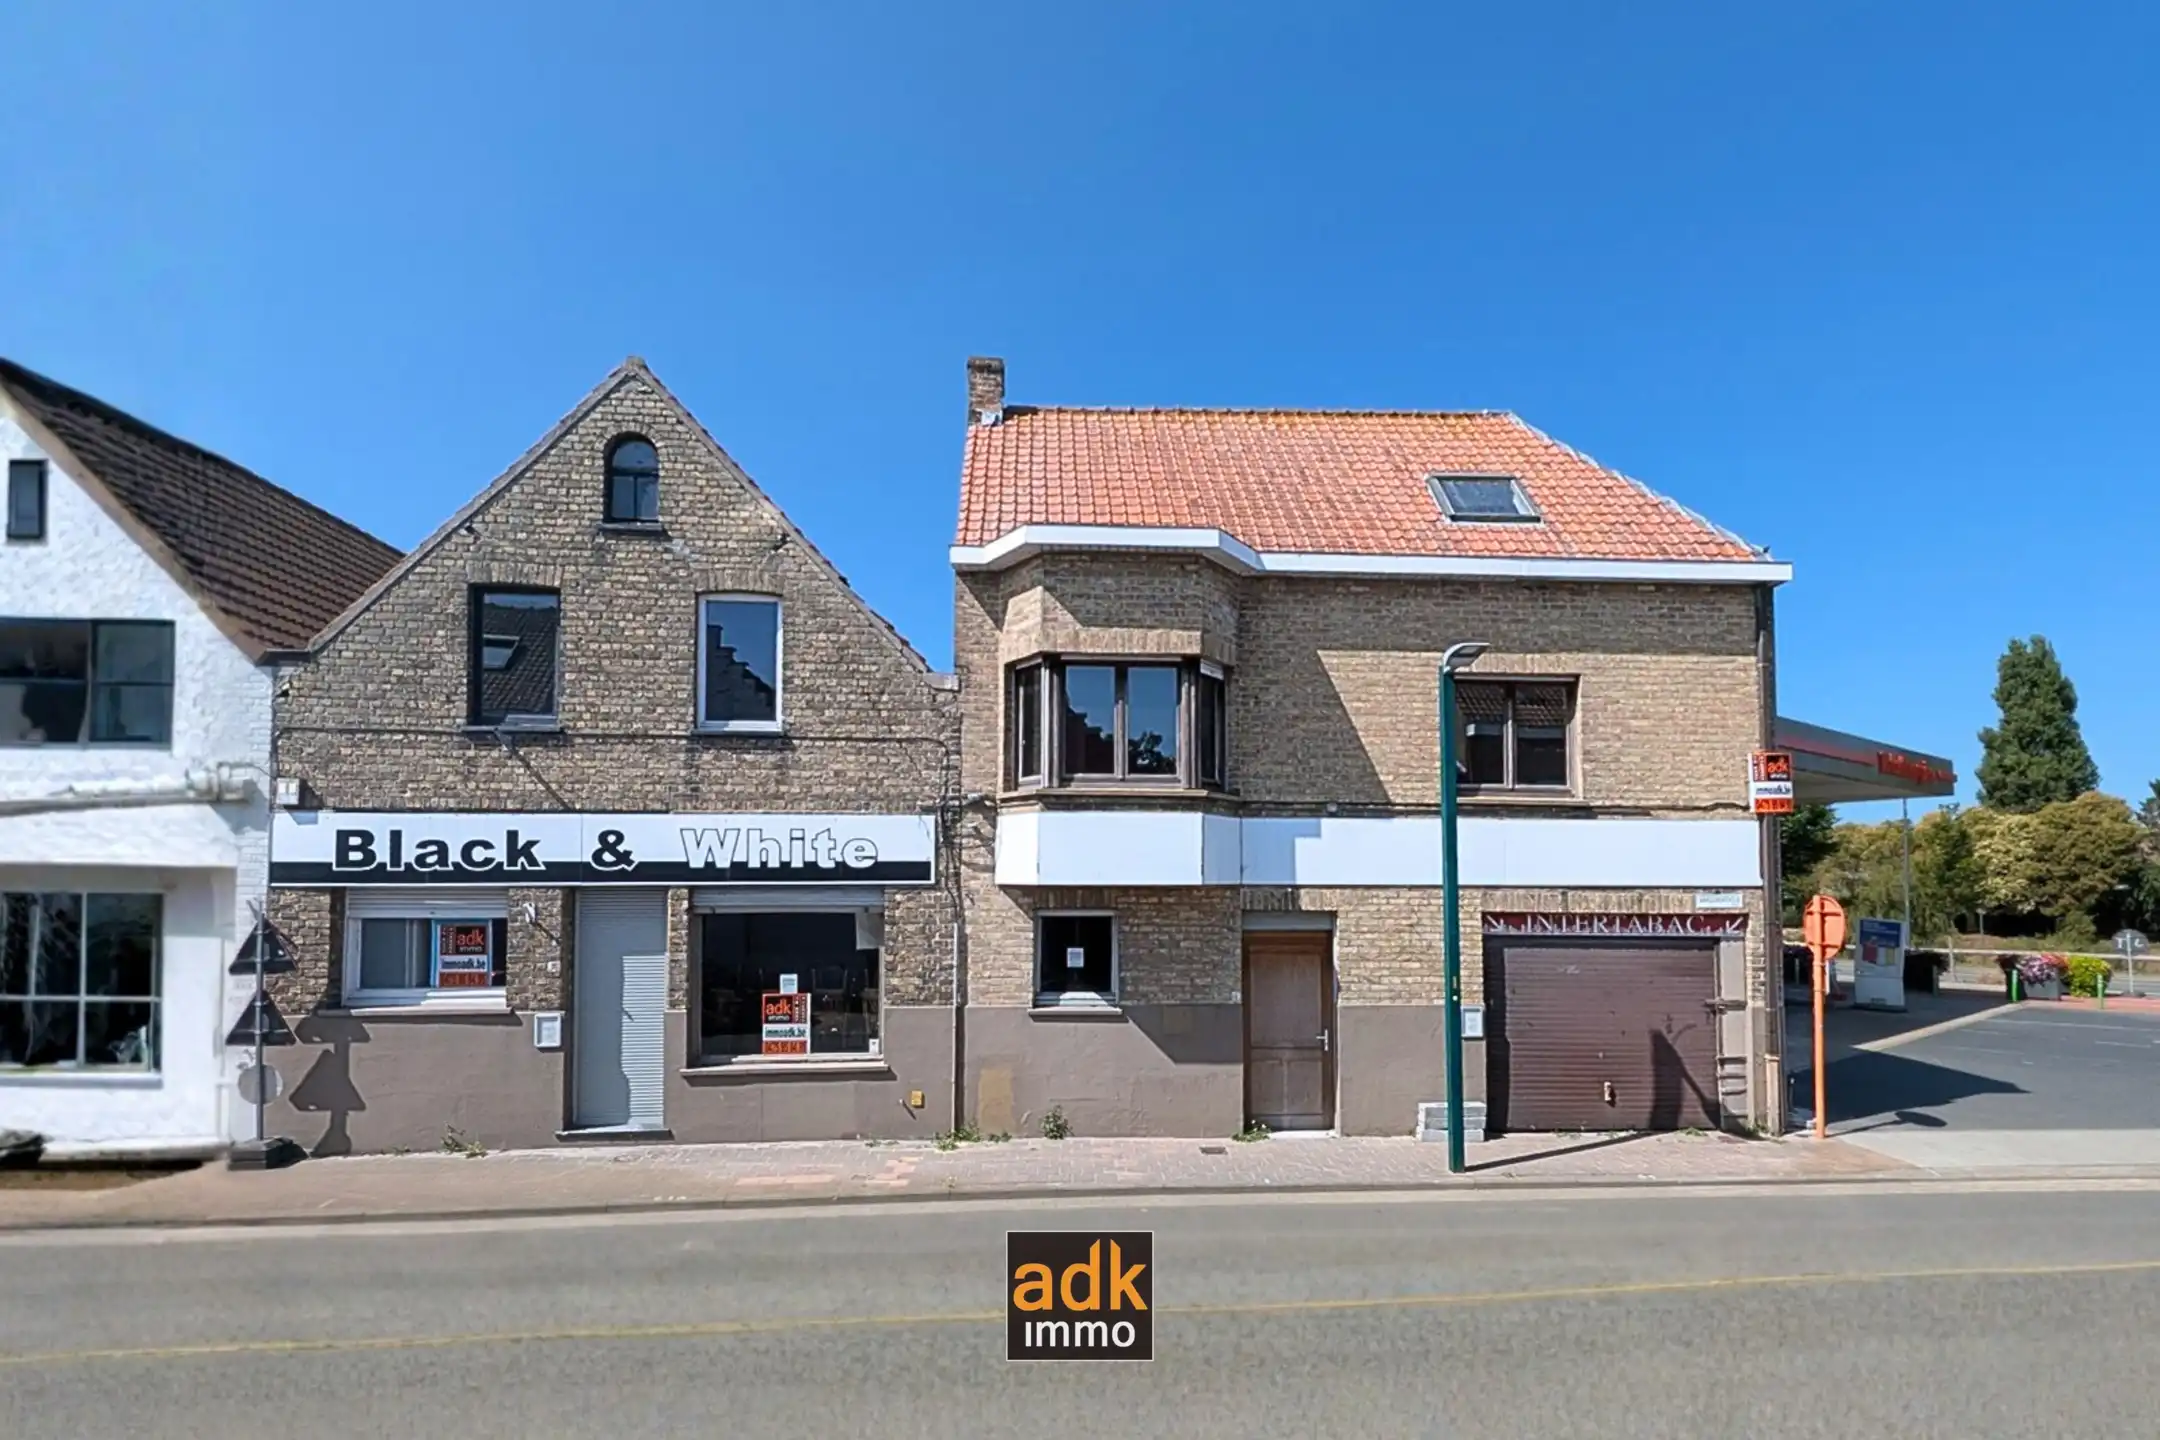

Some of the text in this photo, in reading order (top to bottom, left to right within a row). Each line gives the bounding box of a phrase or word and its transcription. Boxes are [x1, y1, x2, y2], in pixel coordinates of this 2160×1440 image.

[332, 827, 879, 872] Black & White
[1526, 914, 1705, 934] INTERTABAC
[457, 928, 484, 945] adk
[766, 999, 791, 1015] adk
